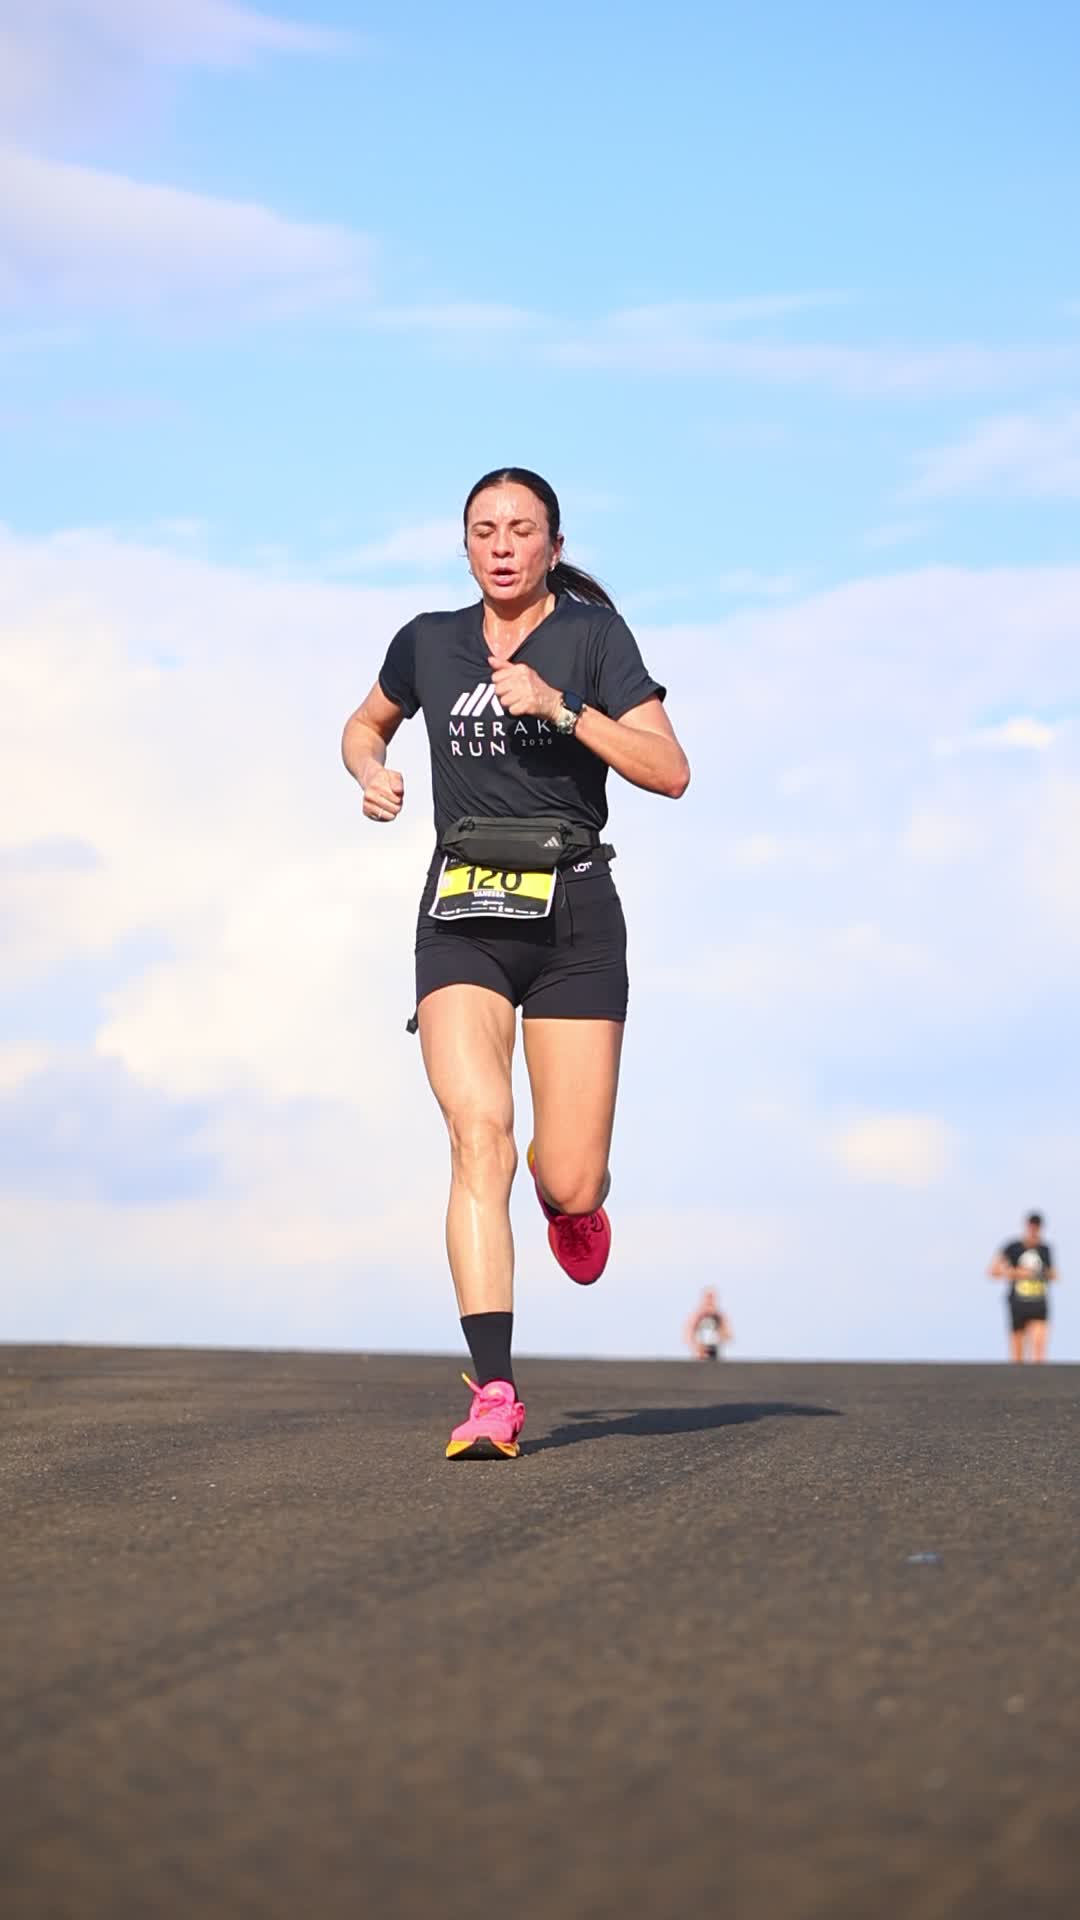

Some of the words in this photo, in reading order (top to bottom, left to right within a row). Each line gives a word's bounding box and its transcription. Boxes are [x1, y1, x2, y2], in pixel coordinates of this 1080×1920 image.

[449, 719, 560, 737] MERAK
[450, 740, 506, 757] RUN
[466, 865, 522, 892] 120
